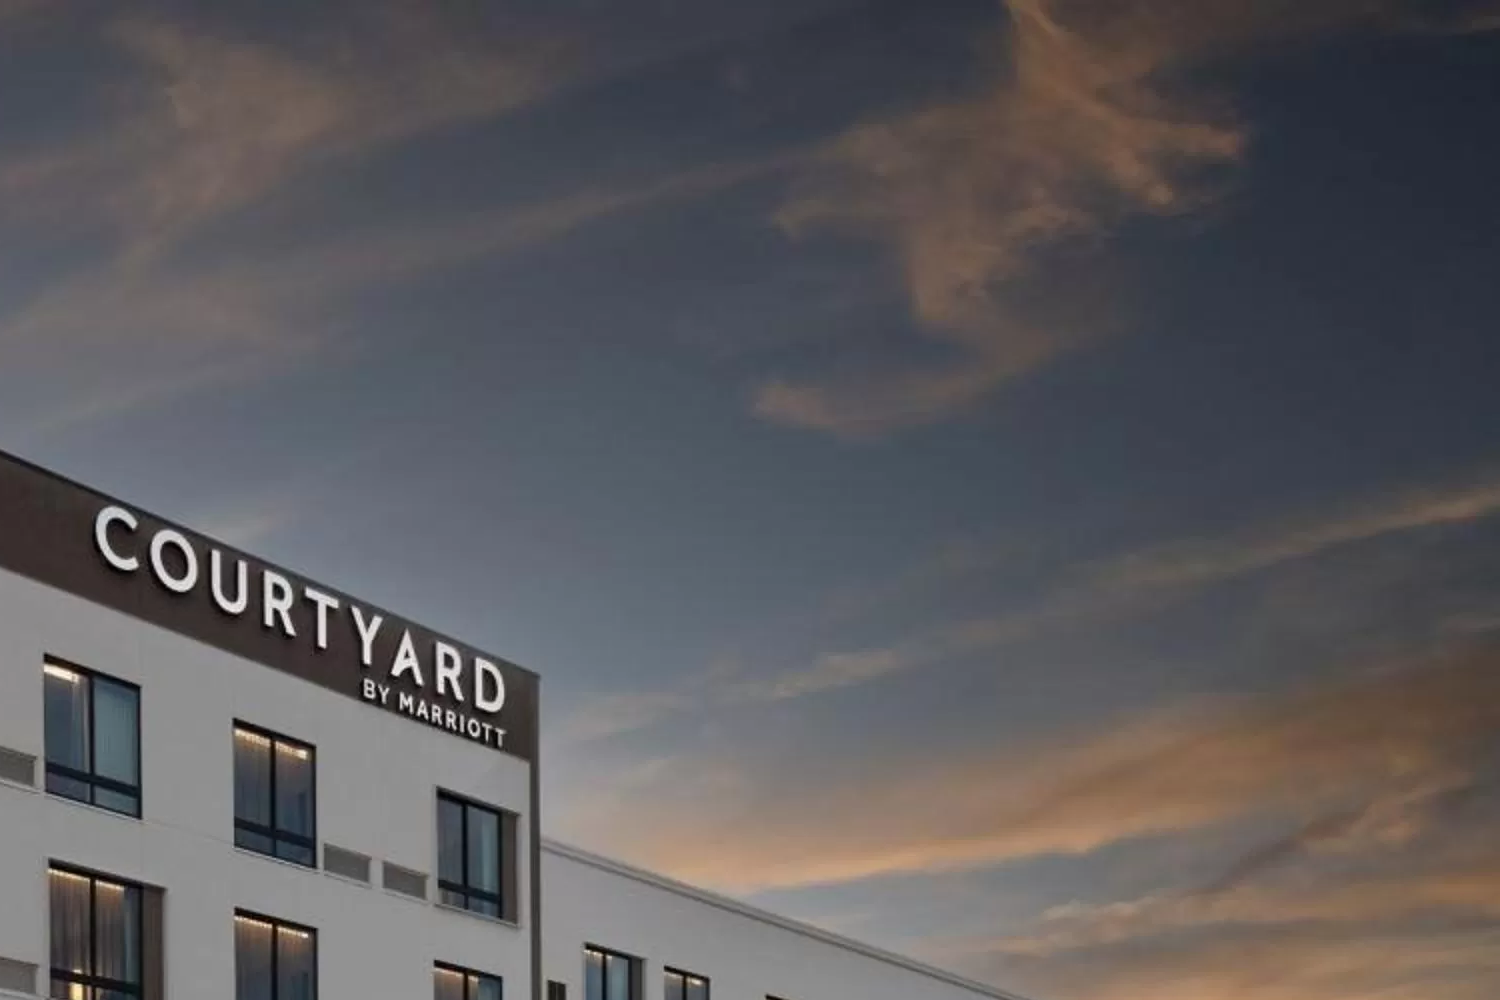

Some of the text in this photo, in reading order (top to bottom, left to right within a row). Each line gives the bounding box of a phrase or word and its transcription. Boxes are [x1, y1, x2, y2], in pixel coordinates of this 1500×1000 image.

[94, 505, 506, 713] COURTYARD
[362, 678, 507, 747] BY MARRIOTT
